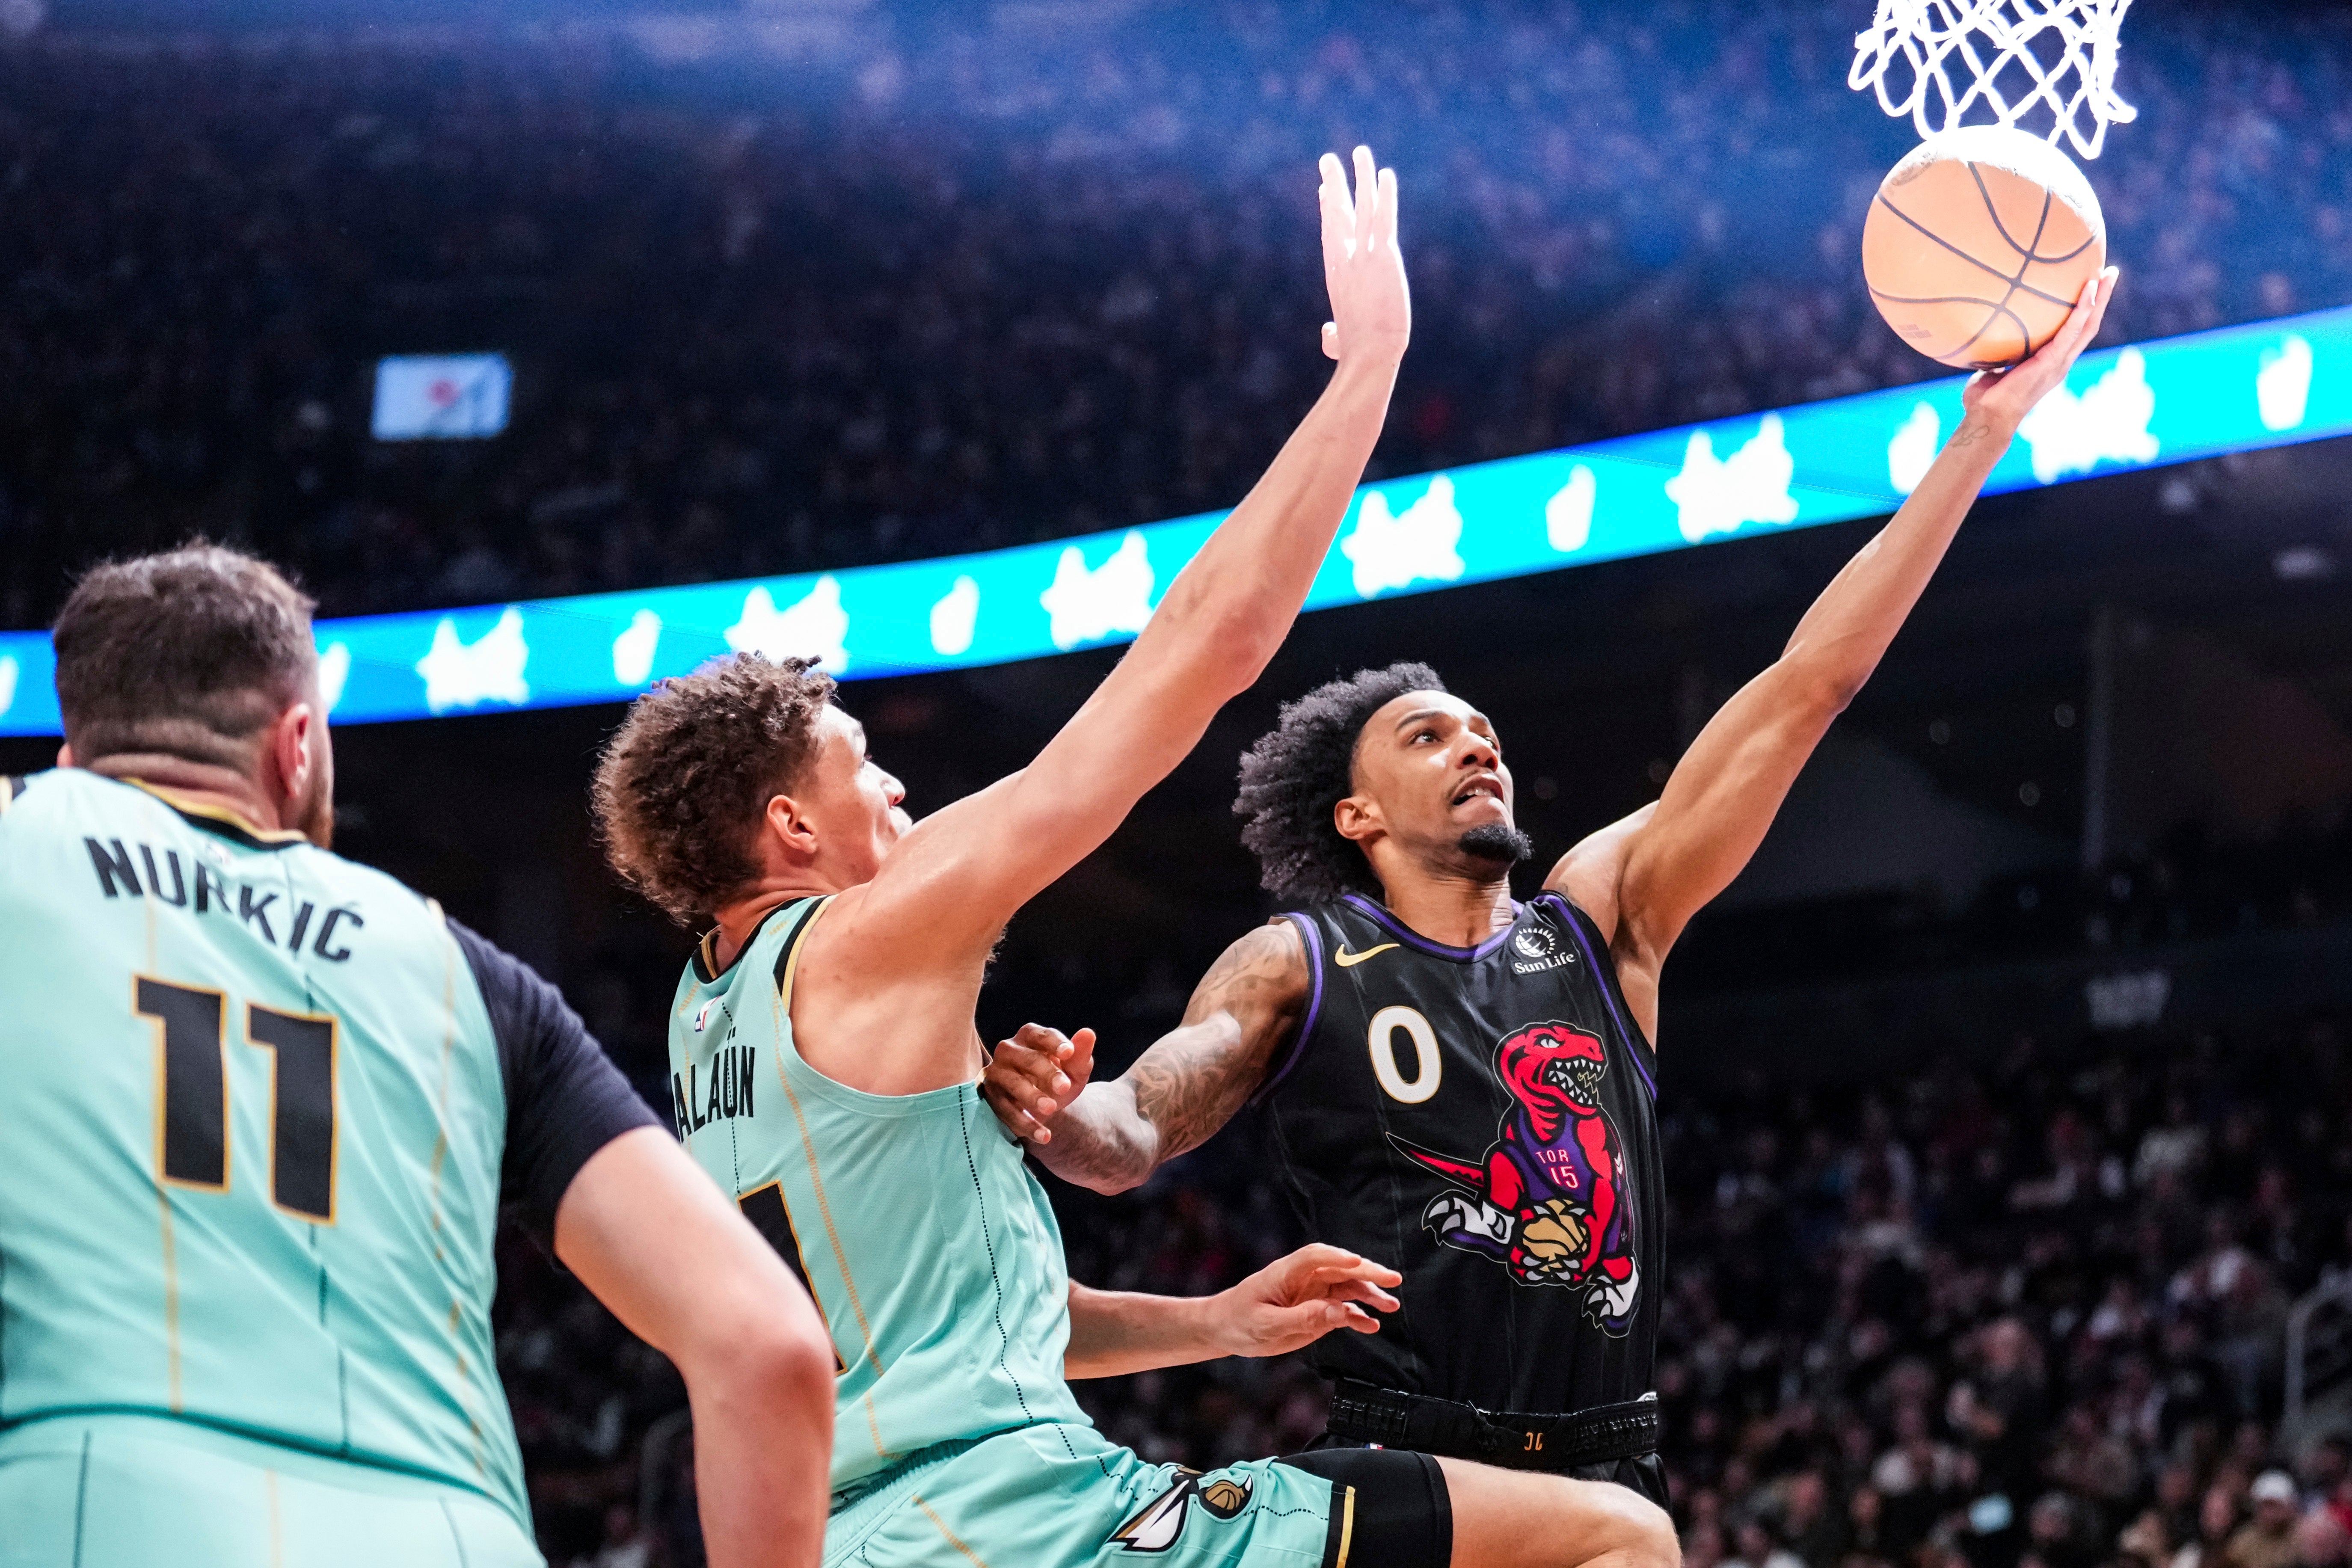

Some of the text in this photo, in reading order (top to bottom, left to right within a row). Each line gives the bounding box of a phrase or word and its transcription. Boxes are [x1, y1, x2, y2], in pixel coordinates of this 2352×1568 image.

[1515, 952, 1575, 973] Sun Life
[1369, 1005, 1441, 1103] 0
[132, 974, 340, 1227] 11
[1535, 1149, 1570, 1164] TOR
[1549, 1165, 1580, 1189] 15
